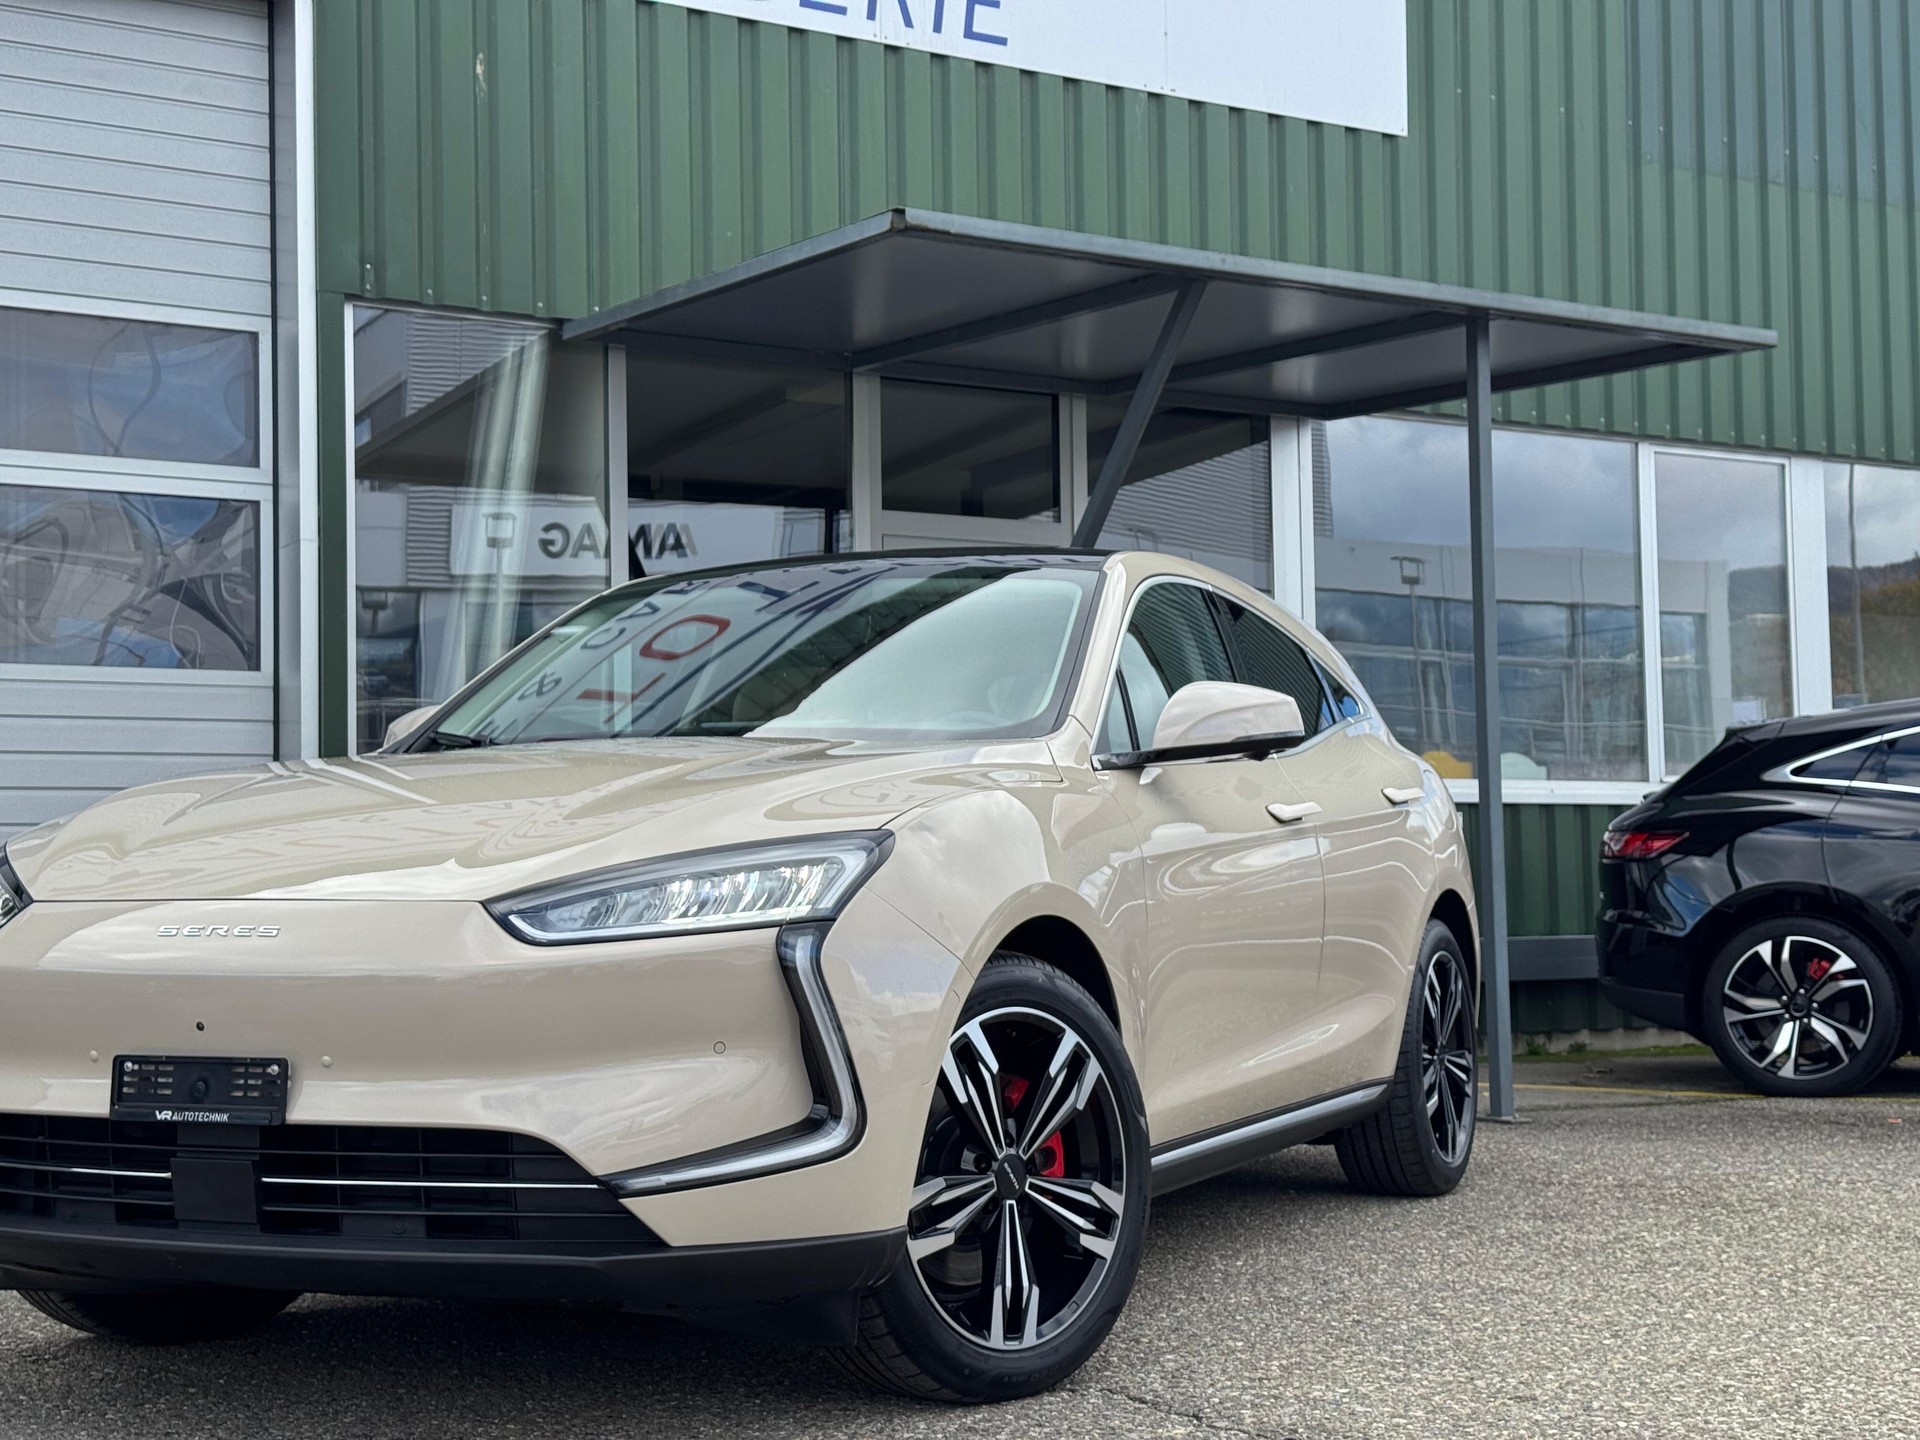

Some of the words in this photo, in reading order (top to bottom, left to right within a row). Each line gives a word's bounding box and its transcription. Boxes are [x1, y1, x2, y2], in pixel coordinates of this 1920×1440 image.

[157, 924, 281, 937] SERES
[155, 1110, 172, 1121] VR
[172, 1111, 230, 1123] AUTOTECHNIK
